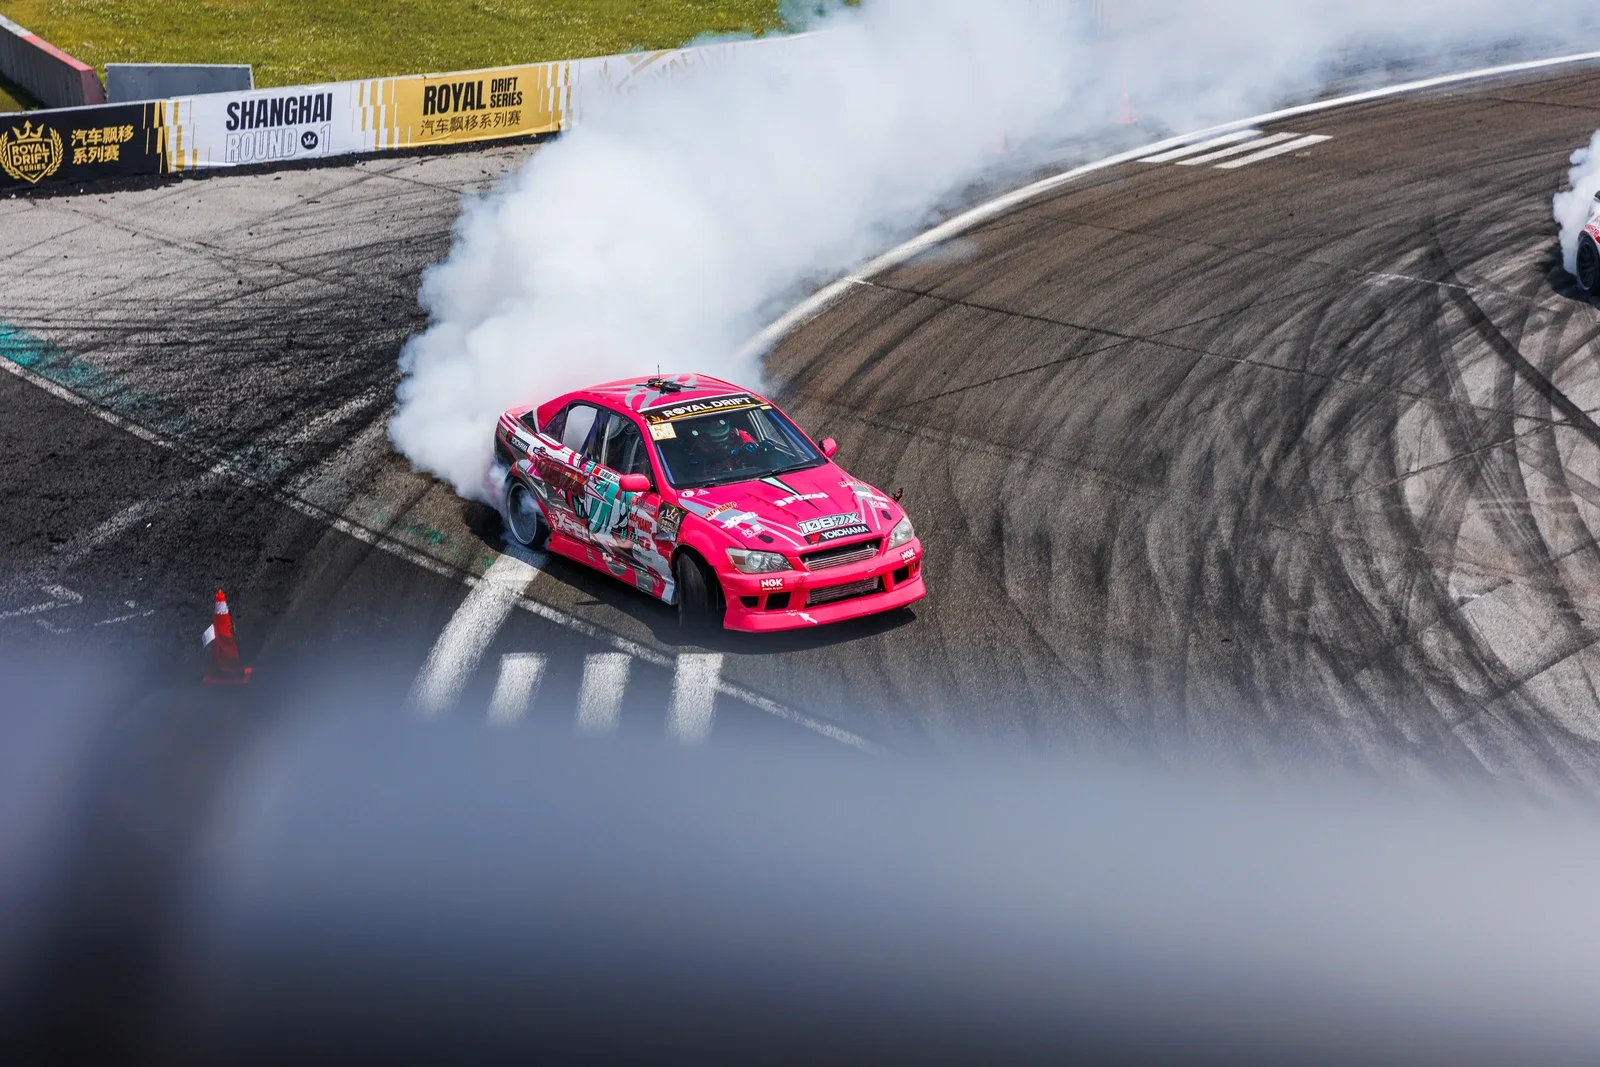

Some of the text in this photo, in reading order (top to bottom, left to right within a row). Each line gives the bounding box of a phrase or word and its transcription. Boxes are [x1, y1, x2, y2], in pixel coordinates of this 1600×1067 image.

[423, 77, 518, 116] ROYAL DRIFT
[490, 92, 522, 108] SERIES
[226, 93, 333, 131] SHANGHAI
[420, 110, 522, 135] 汽车飘移系列赛
[71, 124, 134, 146] 汽车飘移
[225, 123, 331, 163] ROUND 1
[11, 143, 50, 155] ROYAL
[72, 145, 120, 165] 系列赛
[12, 151, 50, 166] DRIFT
[19, 163, 47, 172] SERIES
[662, 396, 750, 418] ROYAL DRIFT
[822, 526, 869, 540] YOKOHAMA
[901, 548, 916, 561] NGK
[761, 578, 783, 588] NGK
